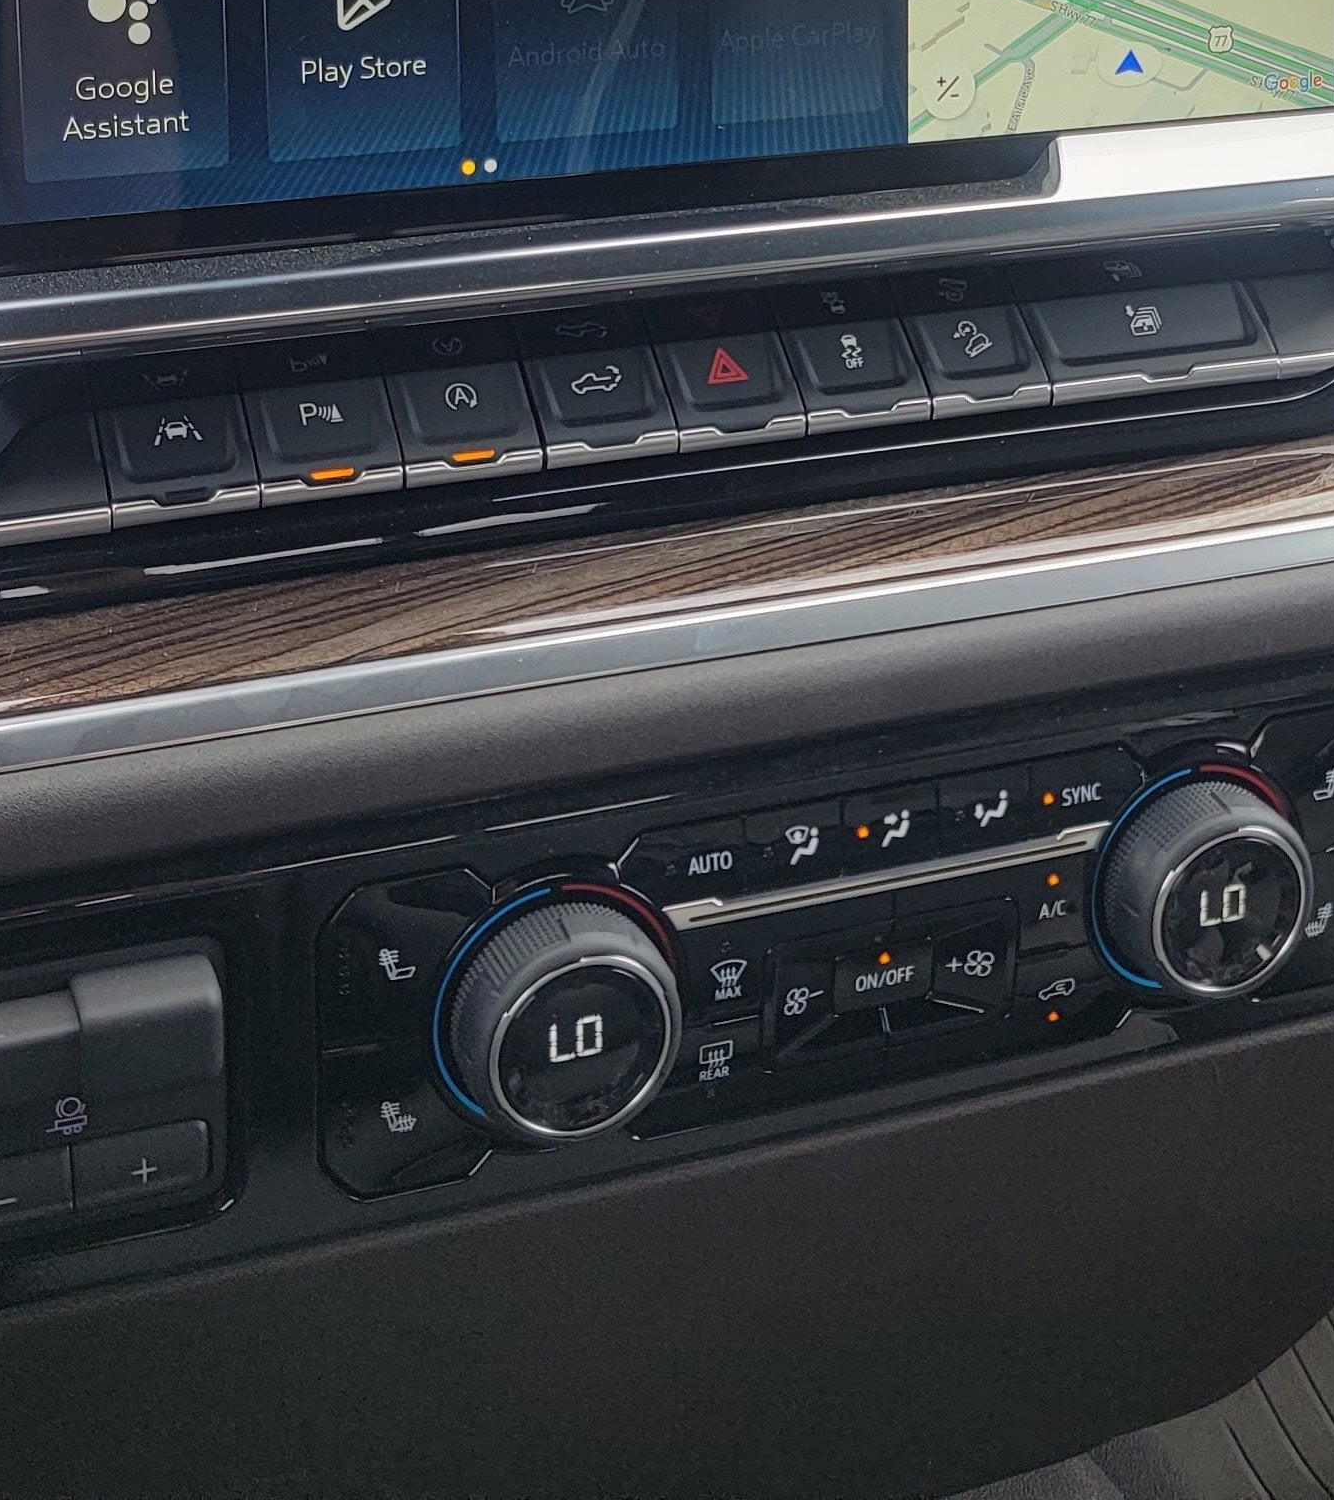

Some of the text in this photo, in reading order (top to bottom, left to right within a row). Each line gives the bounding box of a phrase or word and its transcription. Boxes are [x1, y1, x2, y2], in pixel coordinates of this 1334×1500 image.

[1049, 0, 1097, 26] S Hwy 77
[718, 20, 878, 56] Apple CarPlay
[1214, 35, 1228, 47] 77
[507, 37, 666, 69] Android Auto
[300, 55, 427, 90] Play Store
[1022, 68, 1036, 90] Ave
[1263, 69, 1323, 93] Google
[74, 70, 175, 107] Google
[62, 109, 191, 142] Assistant
[845, 357, 864, 370] OFF
[299, 403, 318, 426] P
[1061, 781, 1103, 807] SYNC
[687, 850, 734, 876] AUTO
[1038, 900, 1067, 920] A/C
[854, 965, 916, 993] ON/OFF
[714, 985, 742, 1000] MAX
[699, 1065, 730, 1081] REAR
